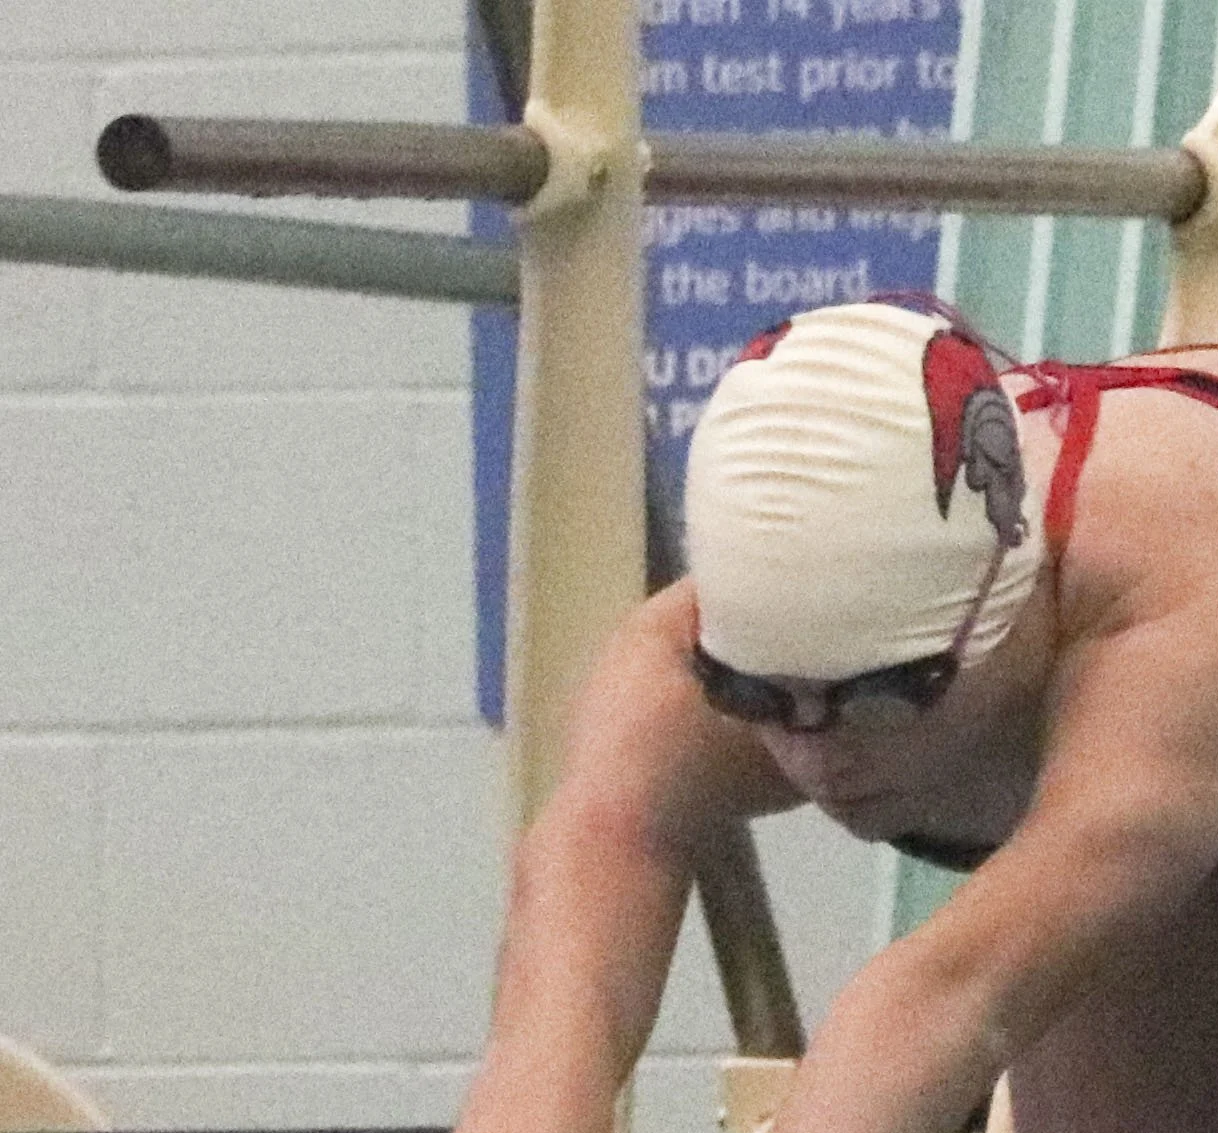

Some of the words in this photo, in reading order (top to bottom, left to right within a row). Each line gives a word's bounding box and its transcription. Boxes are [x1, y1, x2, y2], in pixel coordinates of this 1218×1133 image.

[640, 0, 742, 24] dren
[702, 51, 786, 94] test
[800, 49, 900, 104] prior
[915, 49, 956, 90] to
[662, 261, 731, 306] the
[743, 258, 870, 305] board
[645, 347, 677, 387] U
